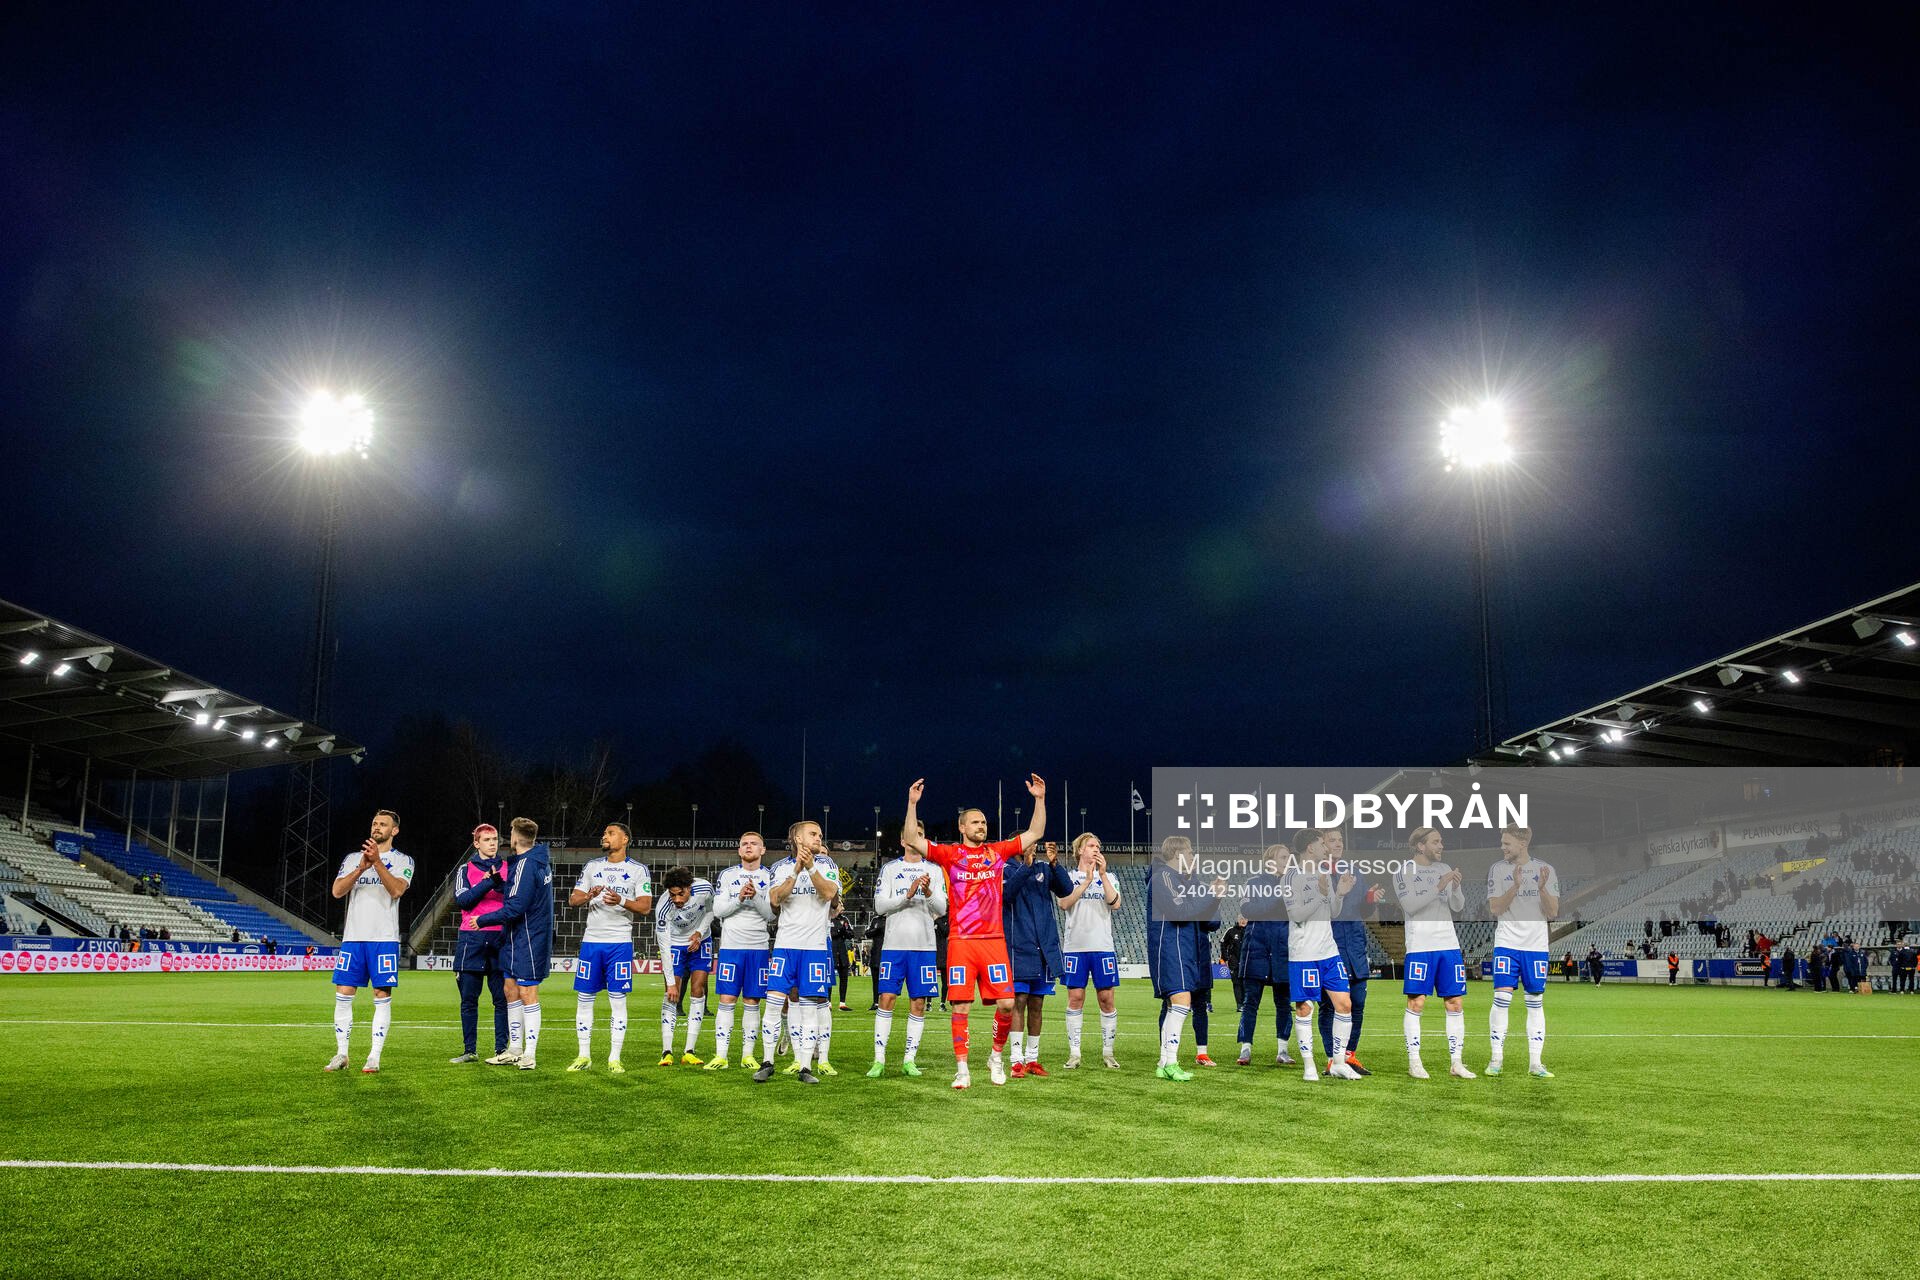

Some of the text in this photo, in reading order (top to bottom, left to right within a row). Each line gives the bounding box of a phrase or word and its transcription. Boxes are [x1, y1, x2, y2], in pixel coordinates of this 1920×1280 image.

[1742, 820, 1821, 840] PLATINUMCARS
[638, 839, 655, 847] ETT
[693, 840, 741, 848] FLYTTFIRM
[1650, 836, 1709, 857] Svenska kyrkan
[957, 870, 996, 880] HOLMEN
[791, 887, 818, 895] OLME
